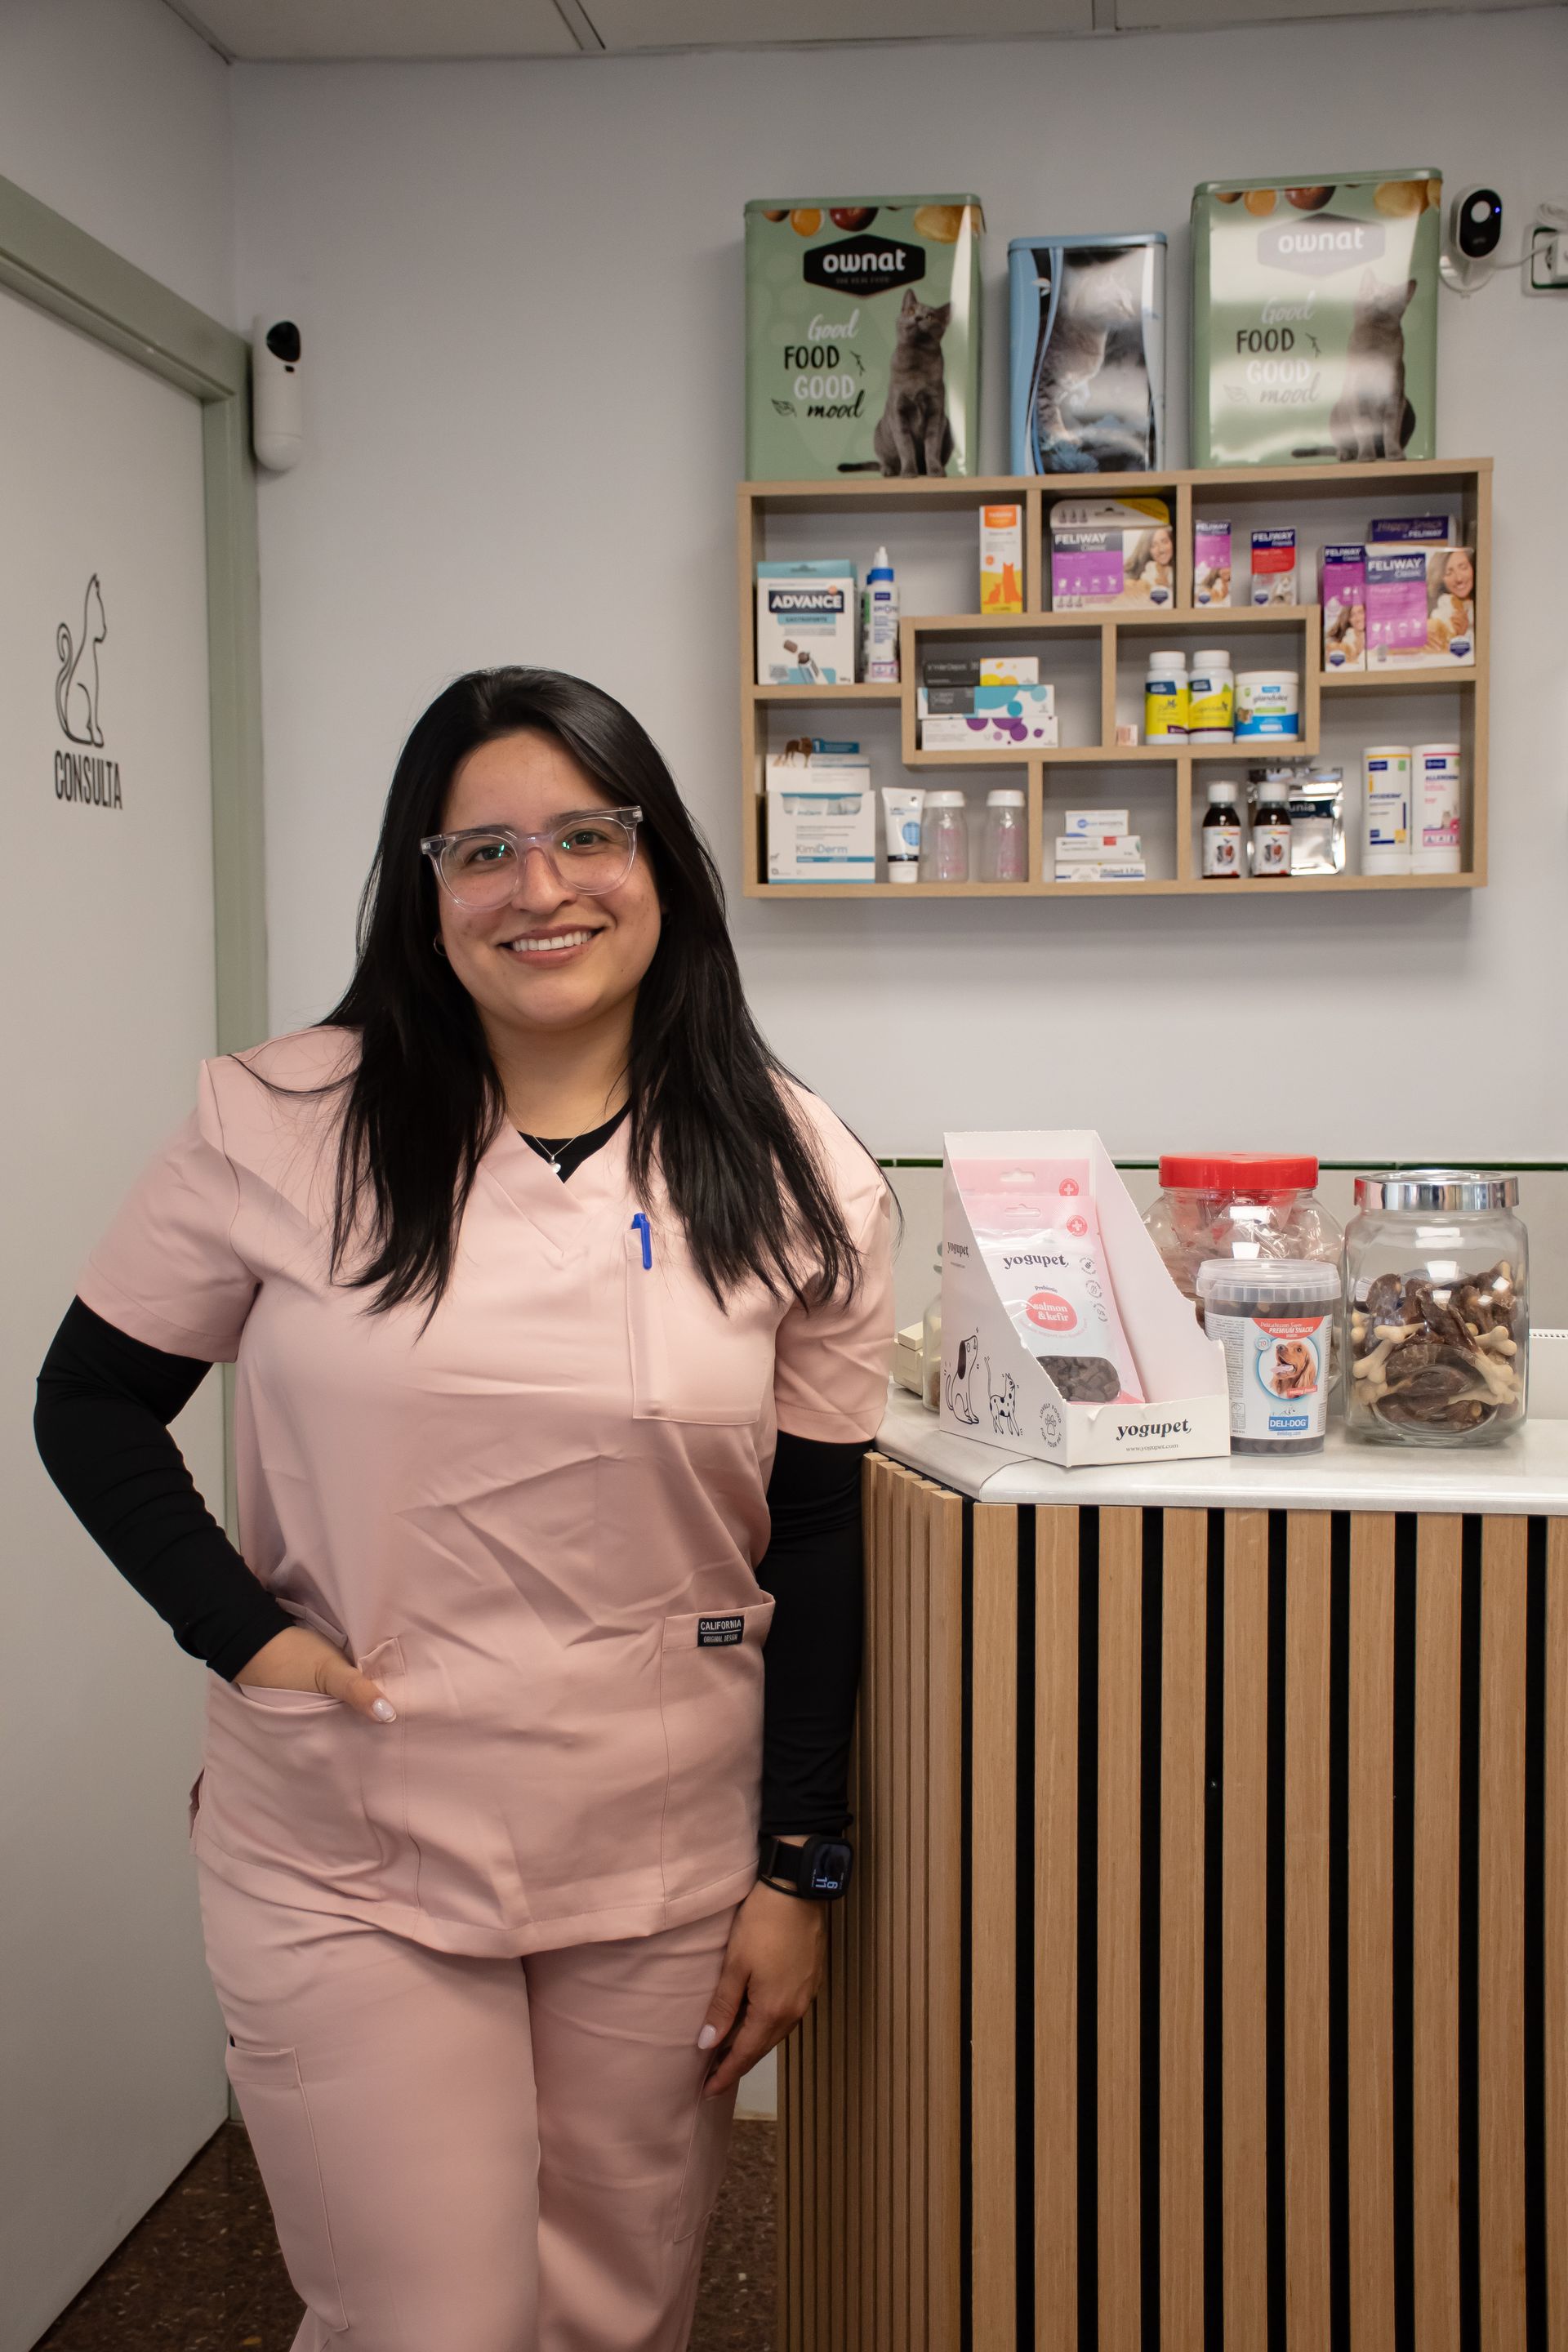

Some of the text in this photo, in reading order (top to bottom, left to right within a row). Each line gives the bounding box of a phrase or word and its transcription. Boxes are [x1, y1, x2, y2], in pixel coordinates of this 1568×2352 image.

[1278, 227, 1365, 255] ownat
[822, 248, 907, 273] ownat
[1261, 289, 1316, 325] Good
[808, 309, 859, 341] Good
[1236, 327, 1294, 354] FOOD
[784, 345, 840, 370] FOOD
[1246, 359, 1312, 384] GOOD
[794, 375, 855, 399] GOOD
[1259, 372, 1320, 404] mood
[807, 390, 865, 419] mood
[1054, 533, 1107, 546] FELIWAY
[1253, 532, 1294, 542] FELIWAY
[1408, 529, 1443, 538] FELIWAY
[1325, 548, 1361, 556] FELIWAY
[1368, 558, 1423, 572] FELIWAY
[771, 595, 842, 609] ADVANCE
[54, 749, 123, 810] CONSULTA
[795, 844, 849, 855] KimiDerm
[1033, 1301, 1068, 1312] salmon
[1270, 1419, 1307, 1428] DELI-DOG
[1125, 1443, 1178, 1452] www.yogupet.com
[700, 1619, 742, 1631] CALIFORNIA
